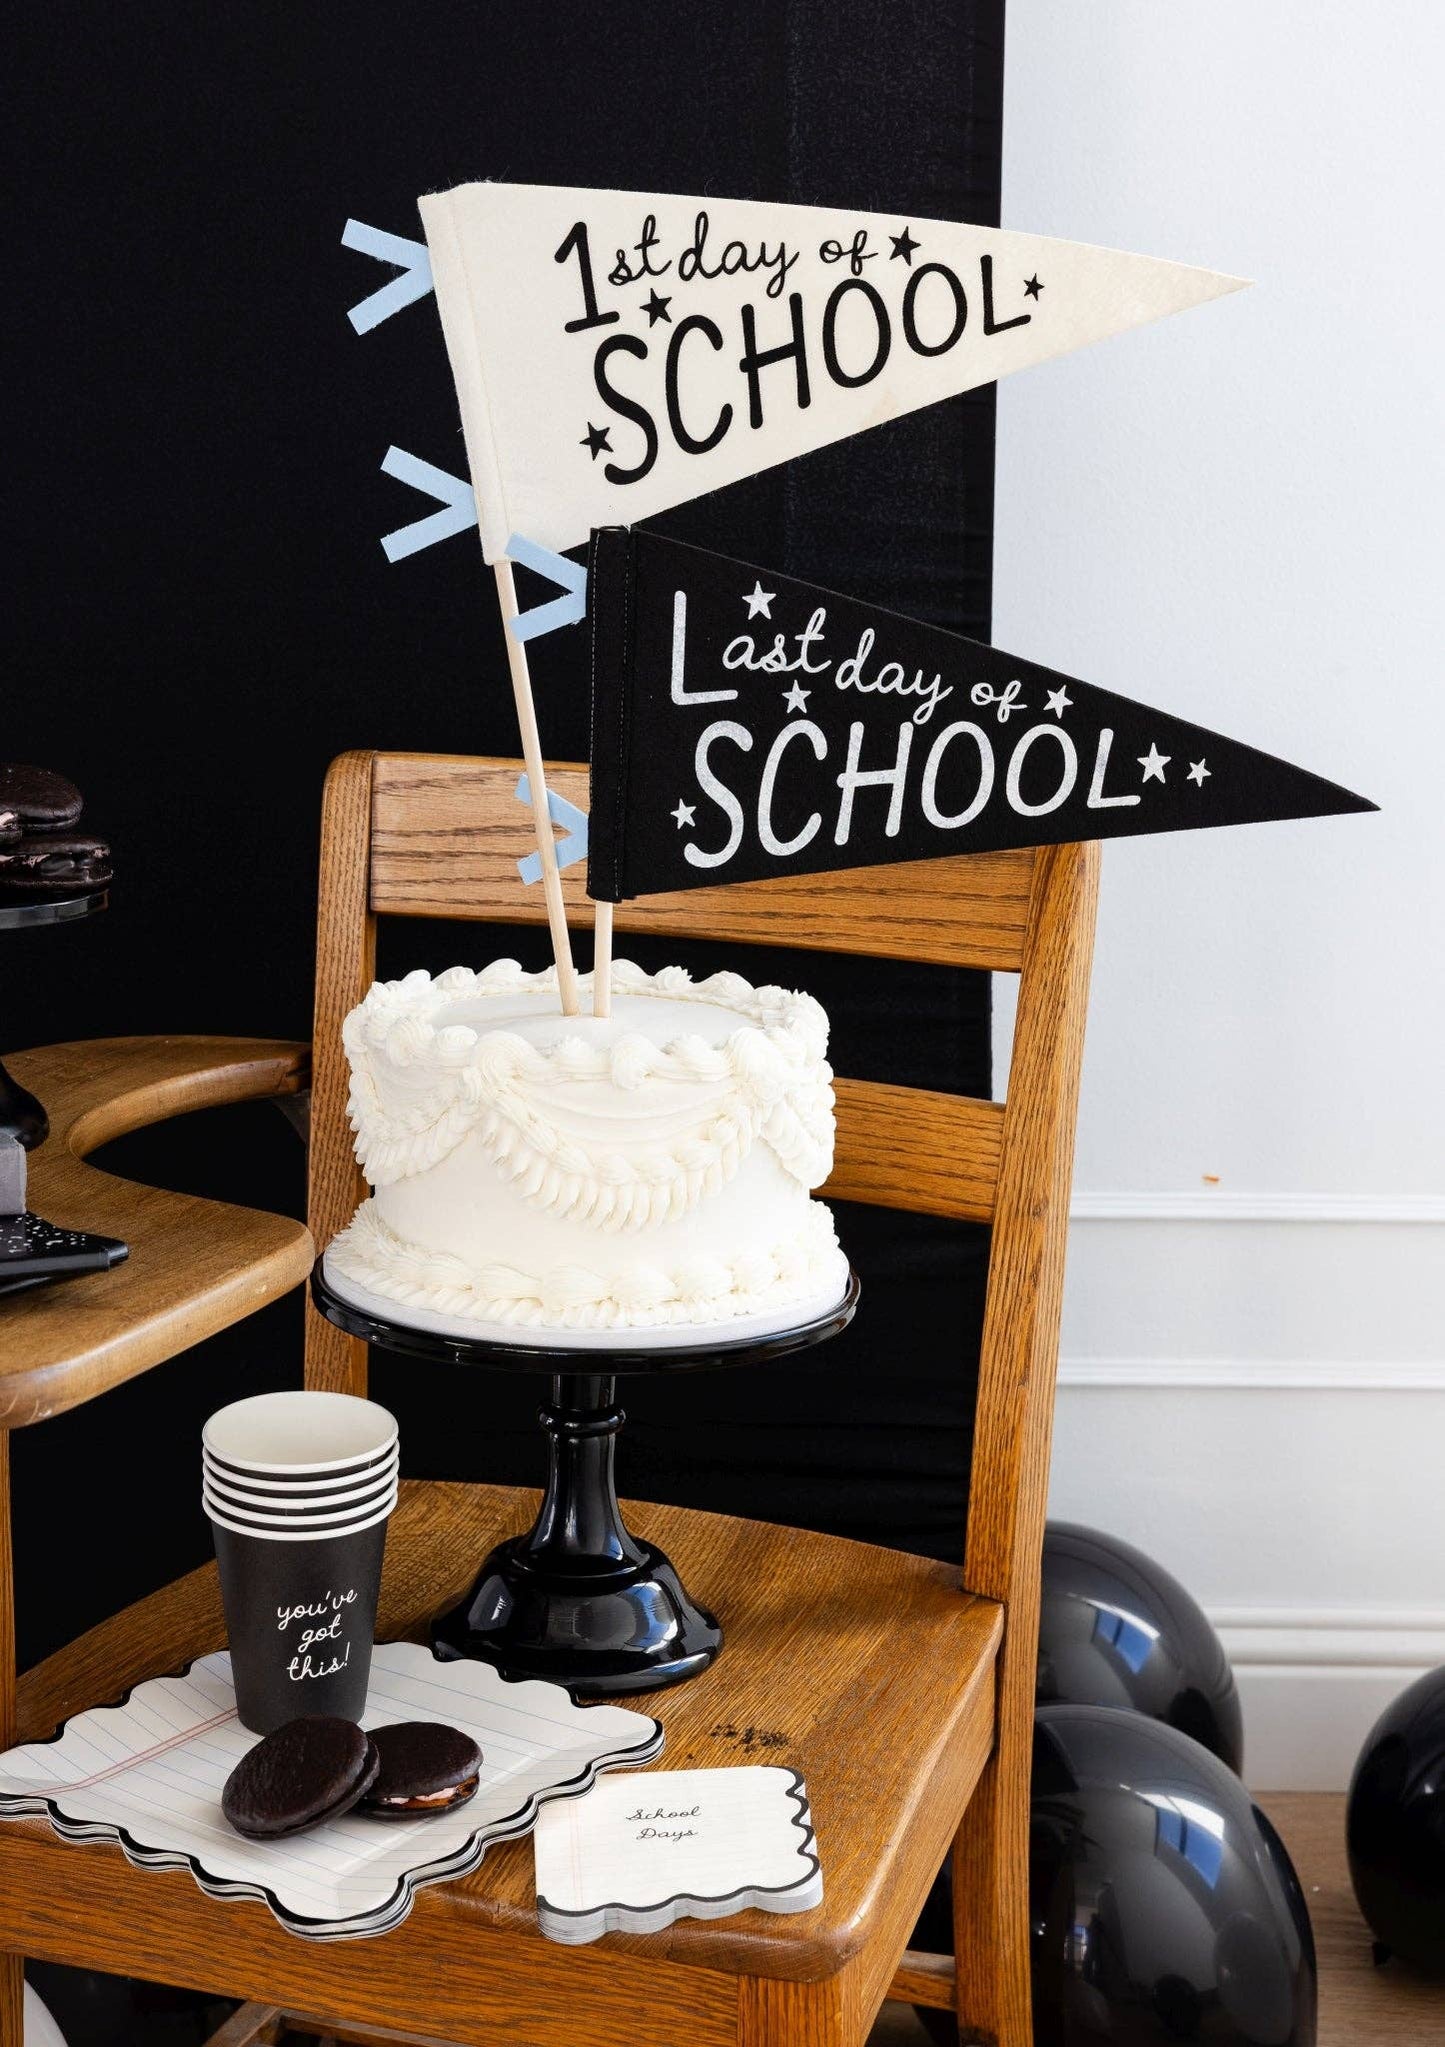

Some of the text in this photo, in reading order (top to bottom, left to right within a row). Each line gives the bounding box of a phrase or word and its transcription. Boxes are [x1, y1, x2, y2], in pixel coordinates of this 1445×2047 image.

[554, 211, 879, 333] 1st day of
[593, 254, 1032, 486] SCHOOL
[670, 590, 1028, 725] Last day of
[683, 719, 1142, 870] SCHOOL
[276, 1588, 358, 1631] you've
[297, 1613, 343, 1653] got
[286, 1641, 350, 1680] this!
[625, 1805, 701, 1821] School
[635, 1826, 699, 1842] Days
